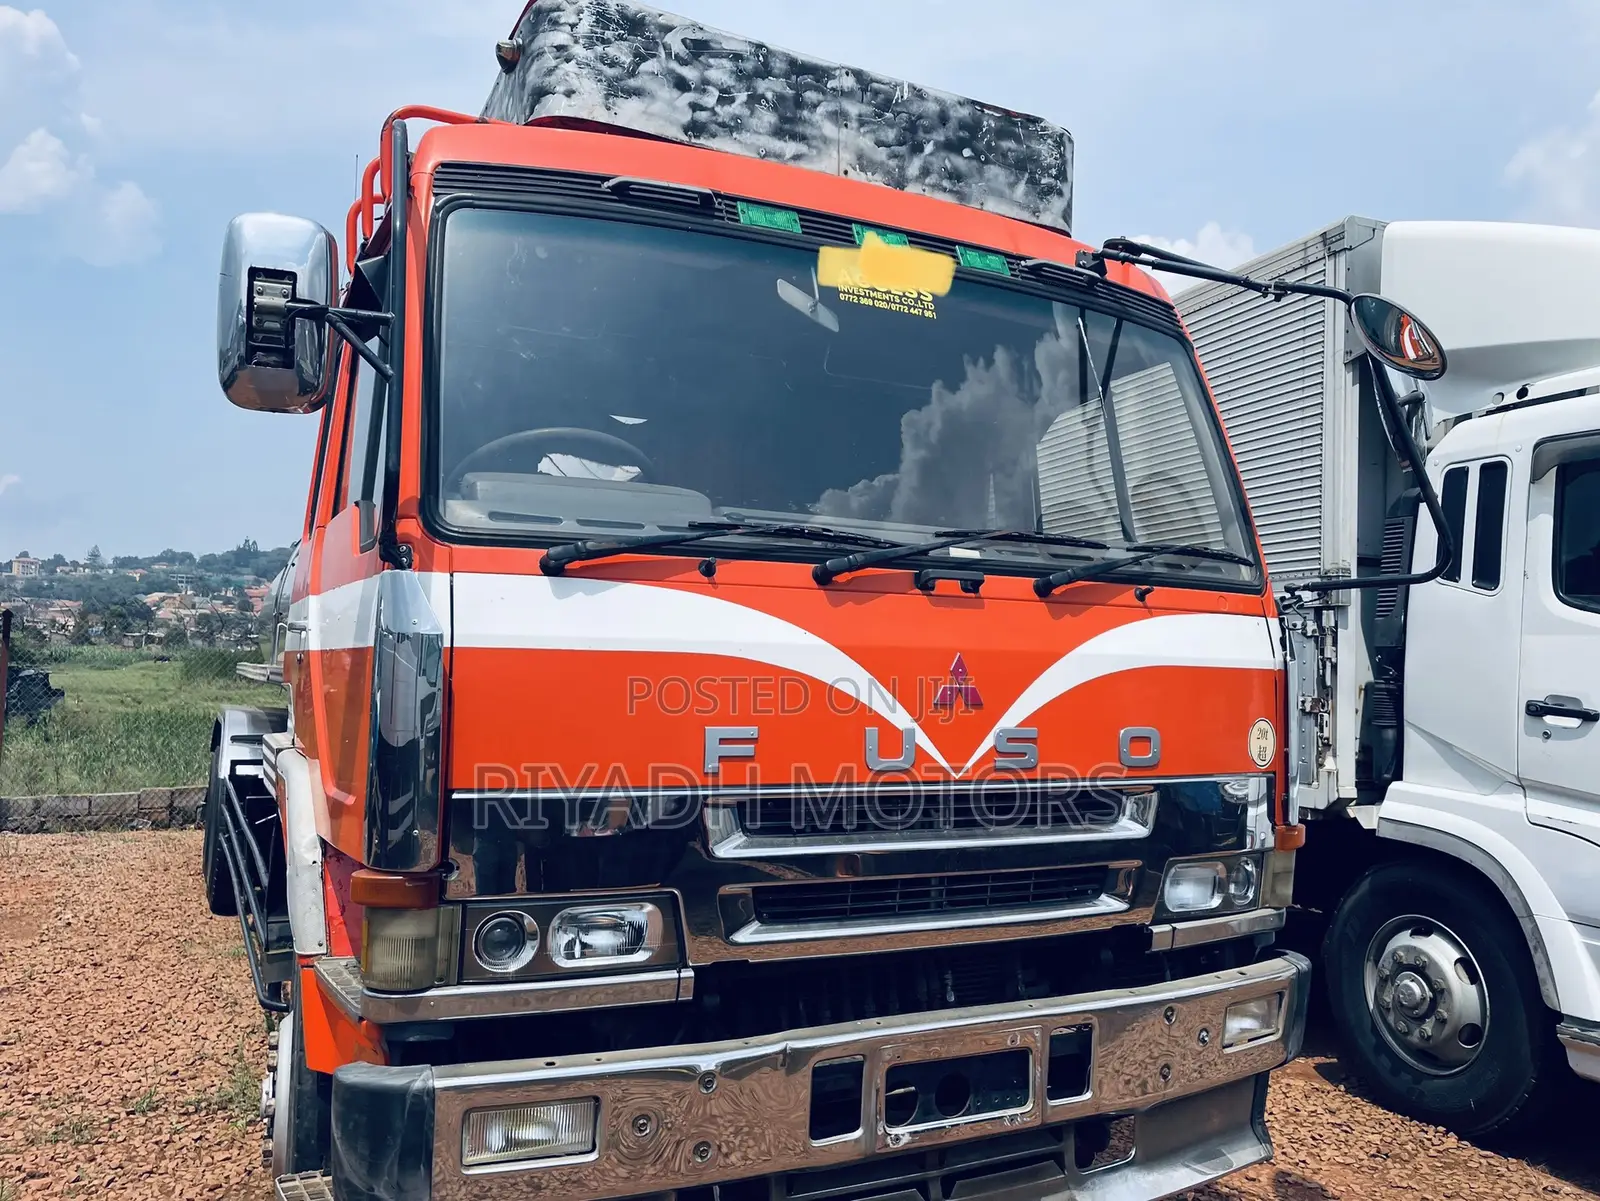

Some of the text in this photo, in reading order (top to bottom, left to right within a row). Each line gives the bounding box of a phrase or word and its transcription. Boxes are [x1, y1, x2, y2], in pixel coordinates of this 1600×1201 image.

[837, 283, 900, 303] INVESTMENTS
[839, 292, 859, 303] 0772
[909, 307, 923, 316] 447
[703, 726, 1162, 774] FUSO
